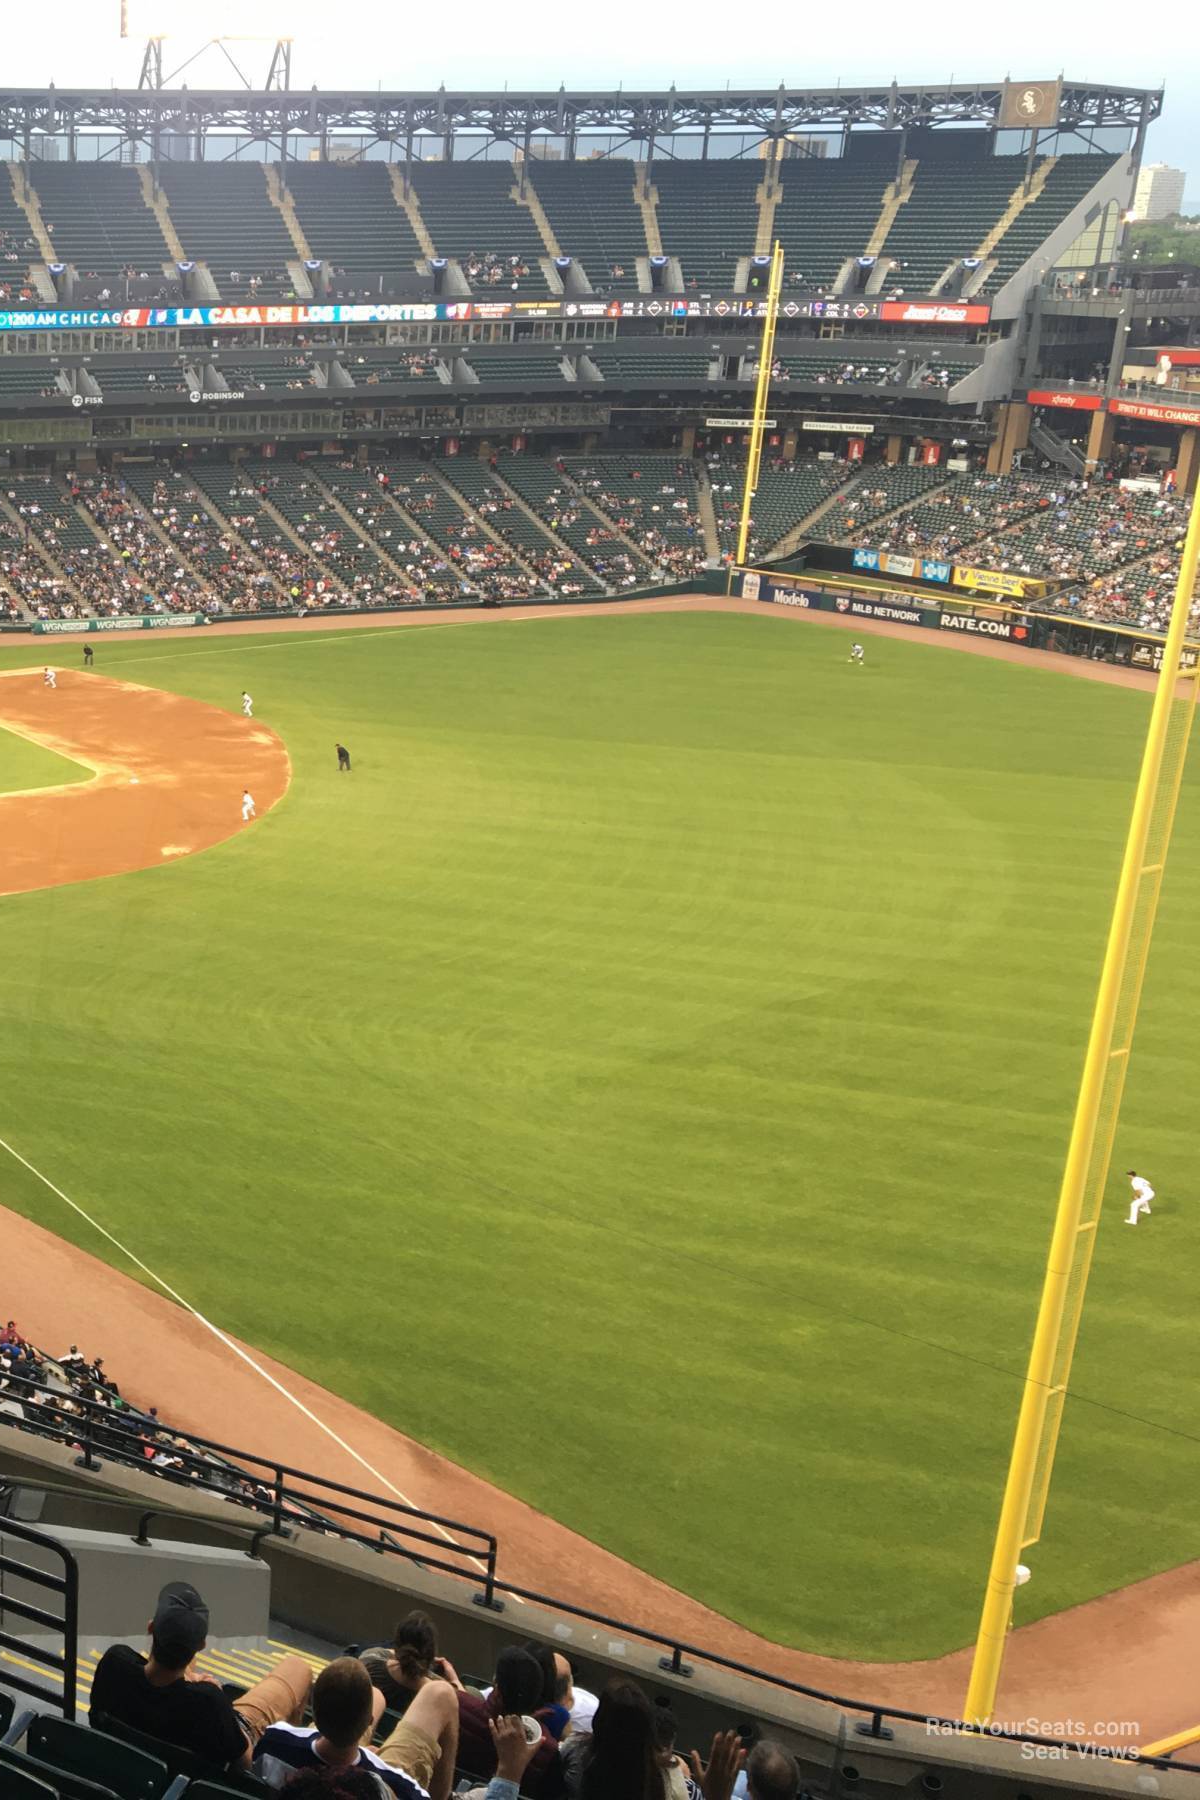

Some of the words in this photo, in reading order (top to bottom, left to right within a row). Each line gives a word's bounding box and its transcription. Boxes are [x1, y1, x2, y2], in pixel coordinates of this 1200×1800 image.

[60, 312, 131, 325] CHICAGO
[209, 308, 262, 323] CASA
[85, 396, 103, 405] FISK
[202, 392, 244, 400] ROBINSON
[774, 589, 809, 608] Modelo
[853, 603, 871, 614] MLB
[874, 606, 920, 622] NETWORK
[940, 615, 1010, 636] RATE.COM
